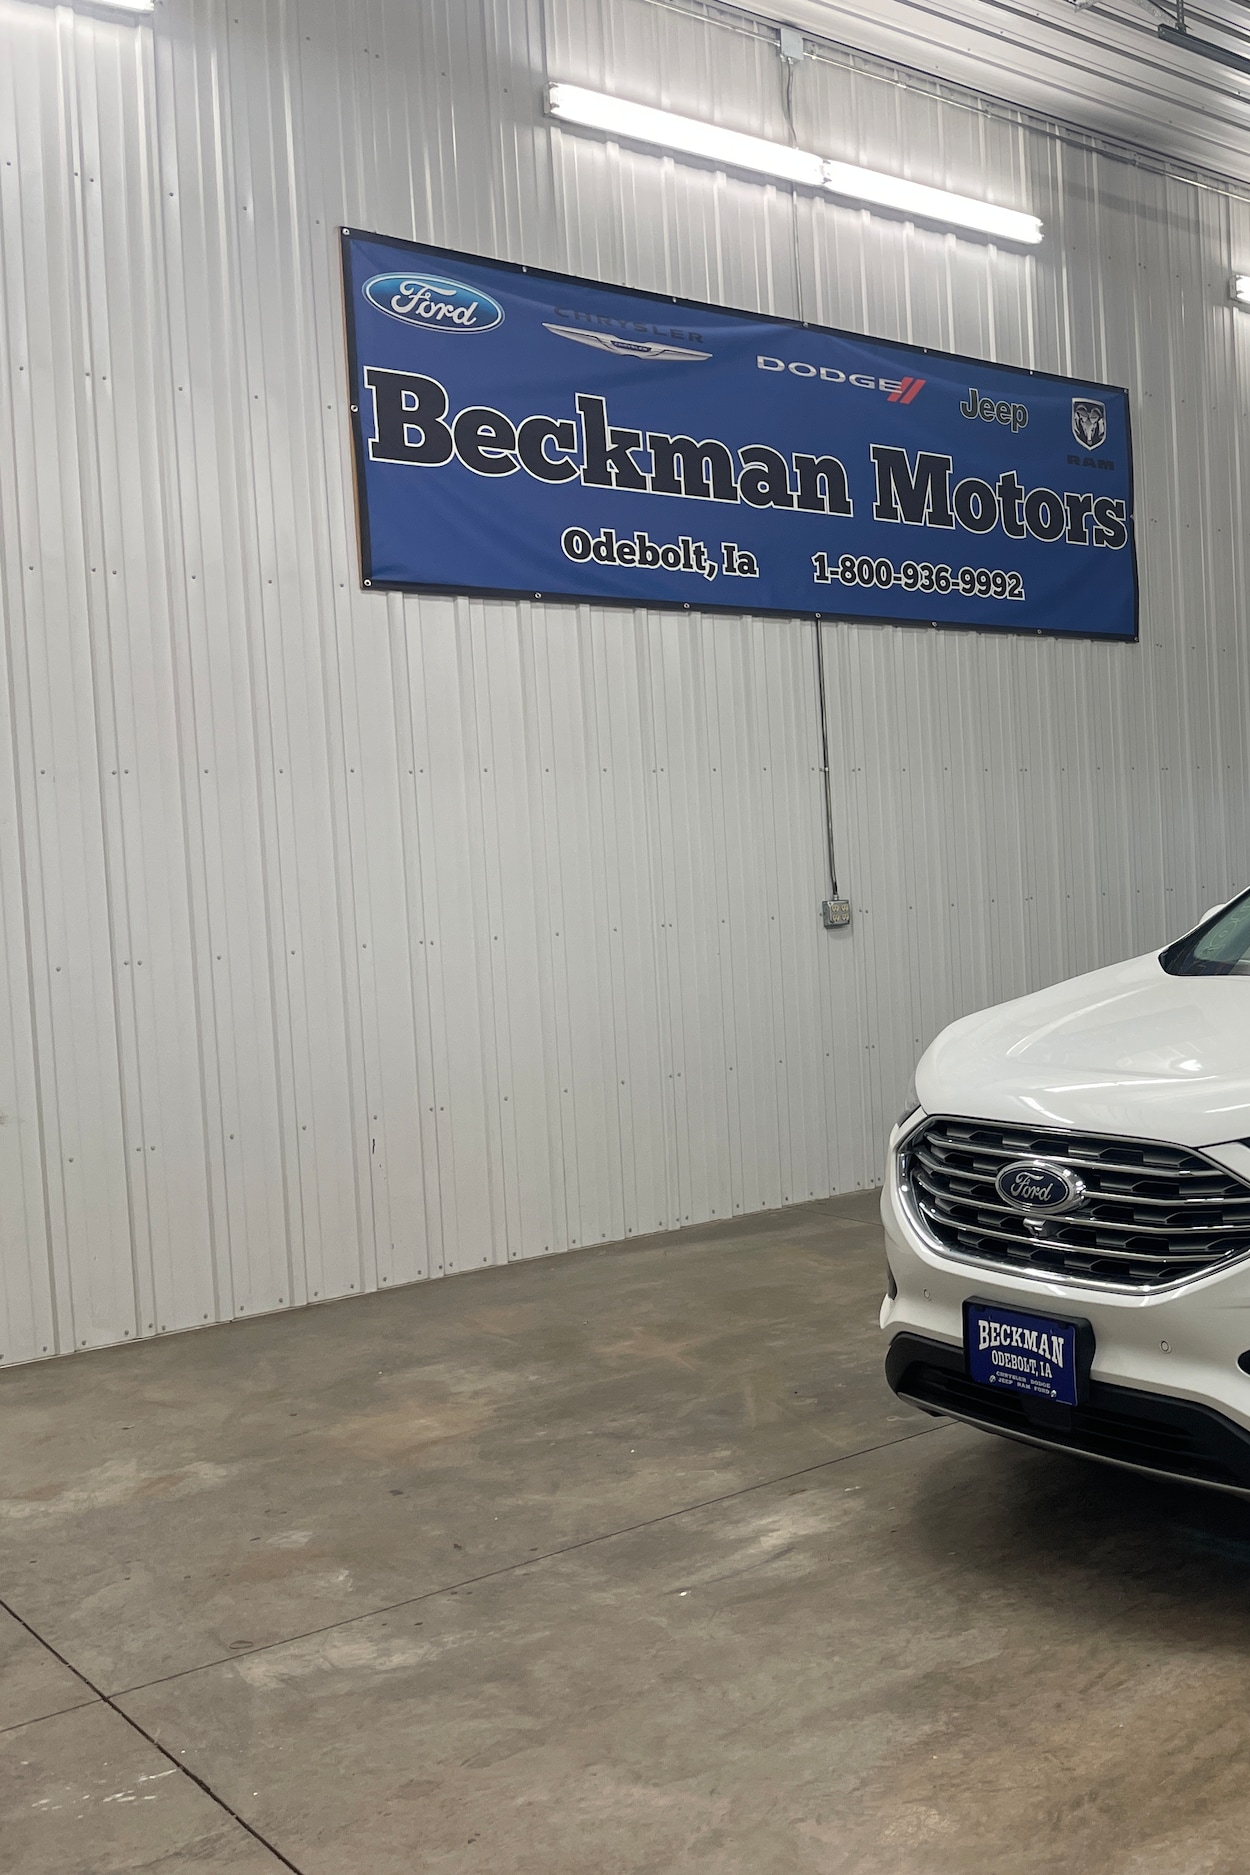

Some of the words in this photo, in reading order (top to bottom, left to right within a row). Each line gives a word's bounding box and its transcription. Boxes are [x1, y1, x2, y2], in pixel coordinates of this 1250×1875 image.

[391, 279, 478, 327] Ford
[553, 306, 704, 343] CHRYSLER
[757, 355, 903, 394] DODGE
[960, 388, 1029, 433] Jeep
[363, 365, 854, 517] Beckman
[869, 443, 1128, 550] Motors
[1066, 454, 1115, 471] RAM
[561, 526, 718, 581] Odebolt,
[722, 542, 760, 579] Ia
[812, 551, 1025, 601] 1-800-936-9992
[1010, 1172, 1054, 1202] Ford
[978, 1319, 1065, 1368] BECKMAN
[991, 1350, 1039, 1377] ODEBOLT,
[1039, 1361, 1053, 1378] IA
[1030, 1379, 1051, 1389] DODGE
[1033, 1385, 1050, 1395] FORD
